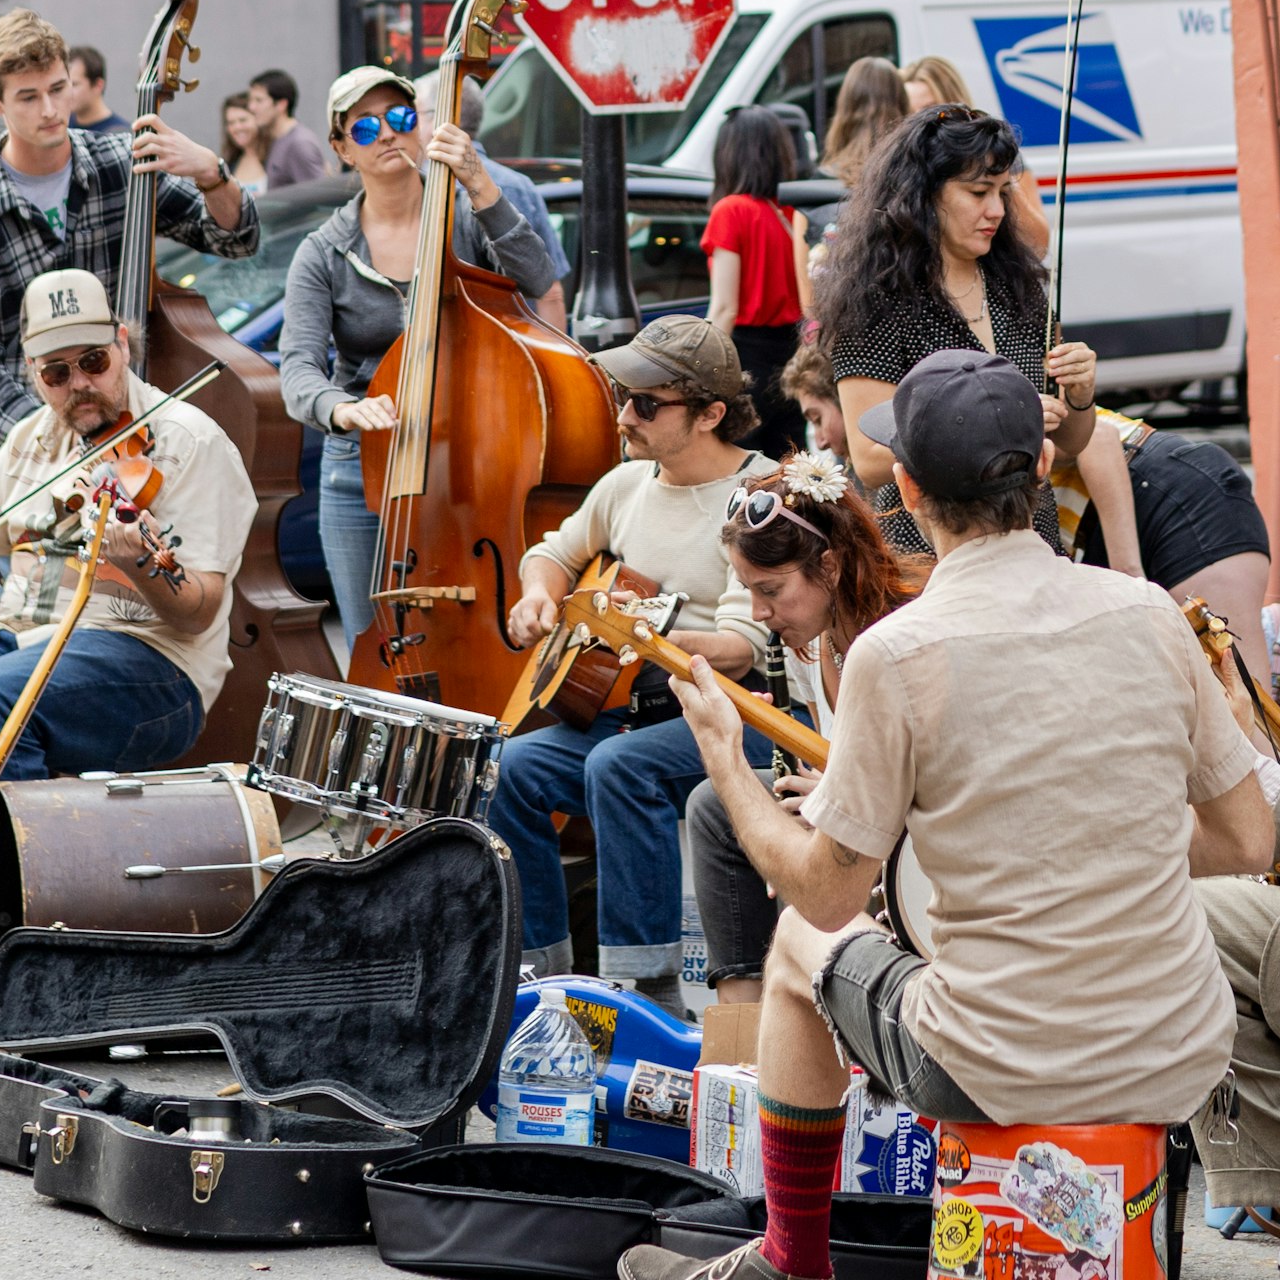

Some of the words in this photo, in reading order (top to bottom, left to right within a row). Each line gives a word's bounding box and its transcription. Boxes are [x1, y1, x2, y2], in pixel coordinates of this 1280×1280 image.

[1178, 8, 1214, 34] We
[587, 1003, 618, 1032] HANS
[522, 1104, 563, 1118] ROUSES
[528, 1115, 554, 1123] MARKETS
[896, 1114, 912, 1155] Blue
[911, 1137, 931, 1192] Pabst
[946, 1202, 972, 1216] SHOP
[1126, 1181, 1161, 1221] Support
